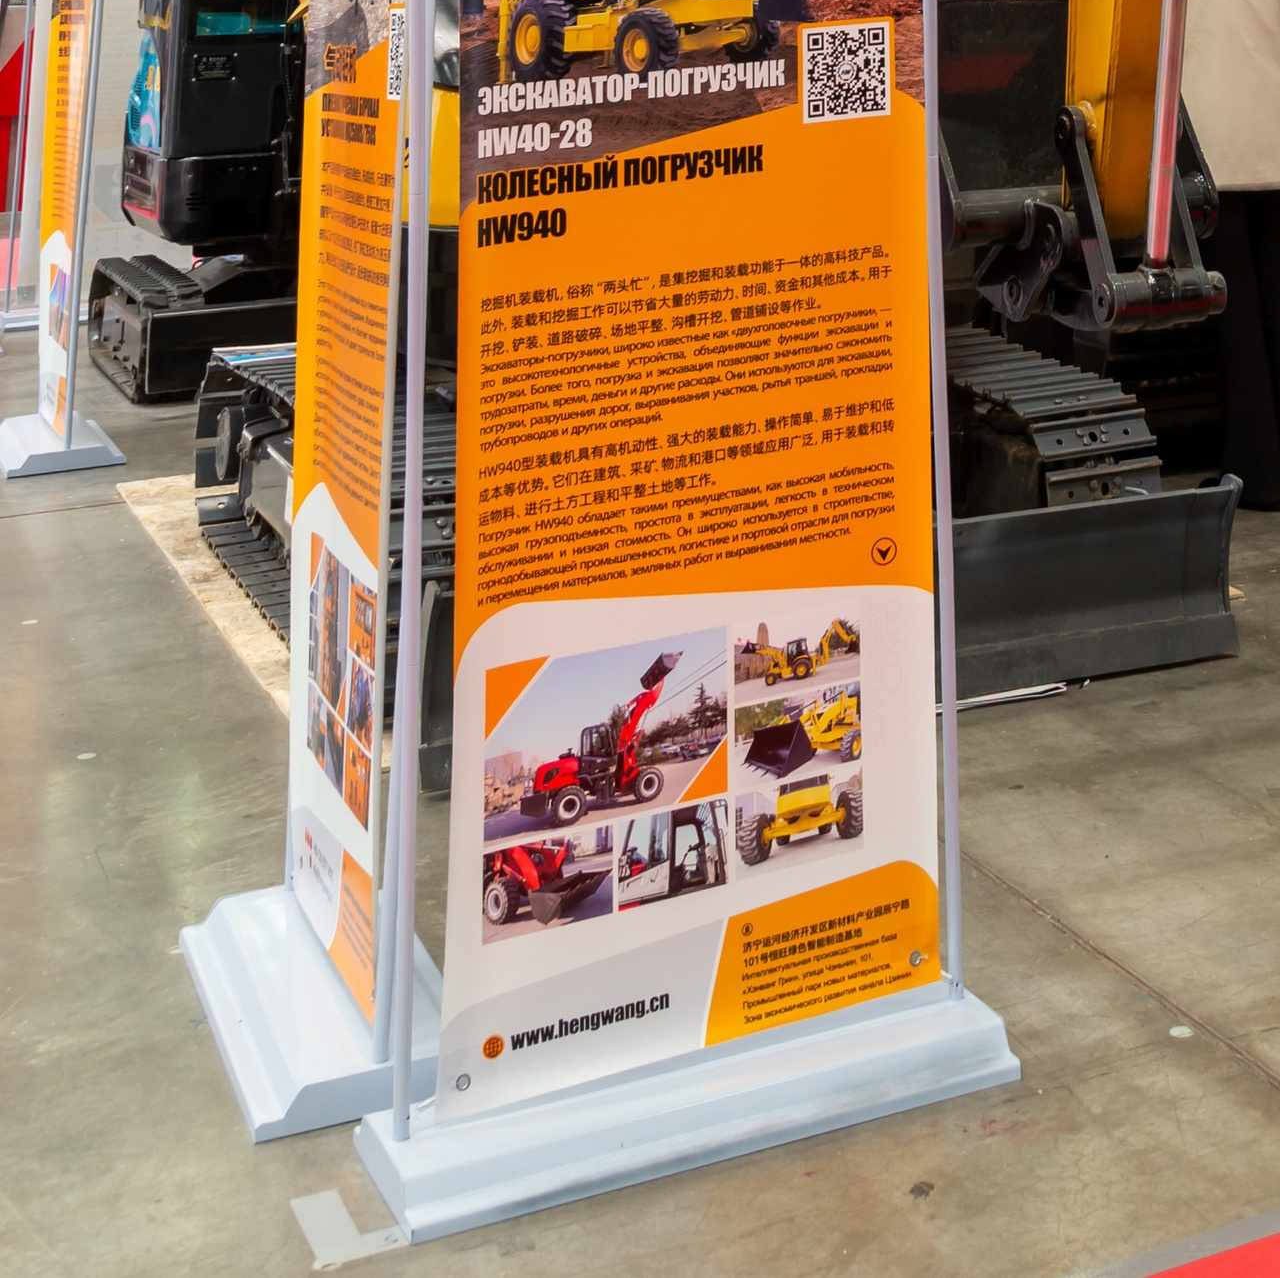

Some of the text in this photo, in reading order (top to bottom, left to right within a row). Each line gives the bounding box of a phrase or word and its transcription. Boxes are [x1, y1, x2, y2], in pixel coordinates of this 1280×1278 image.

[477, 59, 786, 116] ЭКСКАВАТОР-ПОГРУЗЧИК
[477, 119, 593, 159] HW40-28
[477, 144, 764, 205] КОЛЕСНЫЙ ПОГРУЗЧИК
[477, 207, 567, 249] HW940
[480, 346, 611, 375] Экскаваторы-погрузчики,
[613, 340, 655, 354] широко
[656, 332, 710, 348] известные
[731, 316, 816, 338] «двухголовочные
[817, 308, 878, 323] погрузчики»,
[480, 388, 527, 405] погрузки.
[530, 382, 563, 395] Более
[566, 379, 592, 390] того,
[595, 371, 642, 386] погрузка
[656, 360, 713, 377] экскавация
[716, 352, 770, 368] позволяют
[773, 342, 833, 360] значительно
[835, 334, 892, 349] сэкономить
[502, 359, 620, 385] высокотехнологичные
[627, 350, 687, 369] устройства,
[693, 337, 771, 357] объединяющие
[777, 330, 819, 346] функции
[825, 321, 879, 337] экскавации
[479, 362, 893, 436] погрузки, разрушения дорог, выравнивания участков, рытья траншей, прокладки
[480, 400, 550, 422] трудозатраты,
[552, 394, 589, 409] время,
[590, 388, 627, 403] деньги
[638, 381, 676, 396] другие
[677, 374, 723, 391] расходы.
[748, 359, 815, 378] используются
[836, 348, 892, 364] экскавации,
[479, 428, 559, 453] трубопроводов
[570, 421, 607, 436] других
[609, 411, 663, 429] операций.
[477, 551, 554, 576] обслуживании
[572, 541, 609, 556] низкая
[614, 532, 671, 549] стоимость.
[697, 519, 738, 534] широко
[742, 505, 808, 526] используется
[823, 490, 894, 511] строительстве,
[478, 524, 531, 544] Погрузчик
[534, 514, 574, 531] HW940
[577, 508, 626, 524] обладает
[630, 501, 668, 515] такими
[671, 485, 762, 509] преимуществами,
[785, 473, 826, 488] высокая
[829, 462, 894, 479] мобильность,
[478, 542, 519, 560] высокая
[525, 524, 628, 550] грузоподъемность,
[634, 514, 682, 532] простота
[700, 498, 769, 519] эксплуатации,
[774, 490, 817, 505] легкость
[833, 475, 894, 493] техническом
[477, 560, 577, 591] горнодобывающей
[579, 545, 677, 571] промышленности,
[678, 535, 730, 553] логистике
[741, 522, 789, 541] портовой
[790, 516, 830, 532] отрасли
[850, 504, 895, 519] погрузки
[485, 581, 559, 604] перемещения
[561, 569, 628, 588] материалов,
[630, 559, 682, 576] земляных
[683, 552, 714, 569] работ
[725, 537, 797, 559] выравнивания
[799, 527, 851, 544] местности.
[510, 991, 671, 1052] www.hengwang.cn
